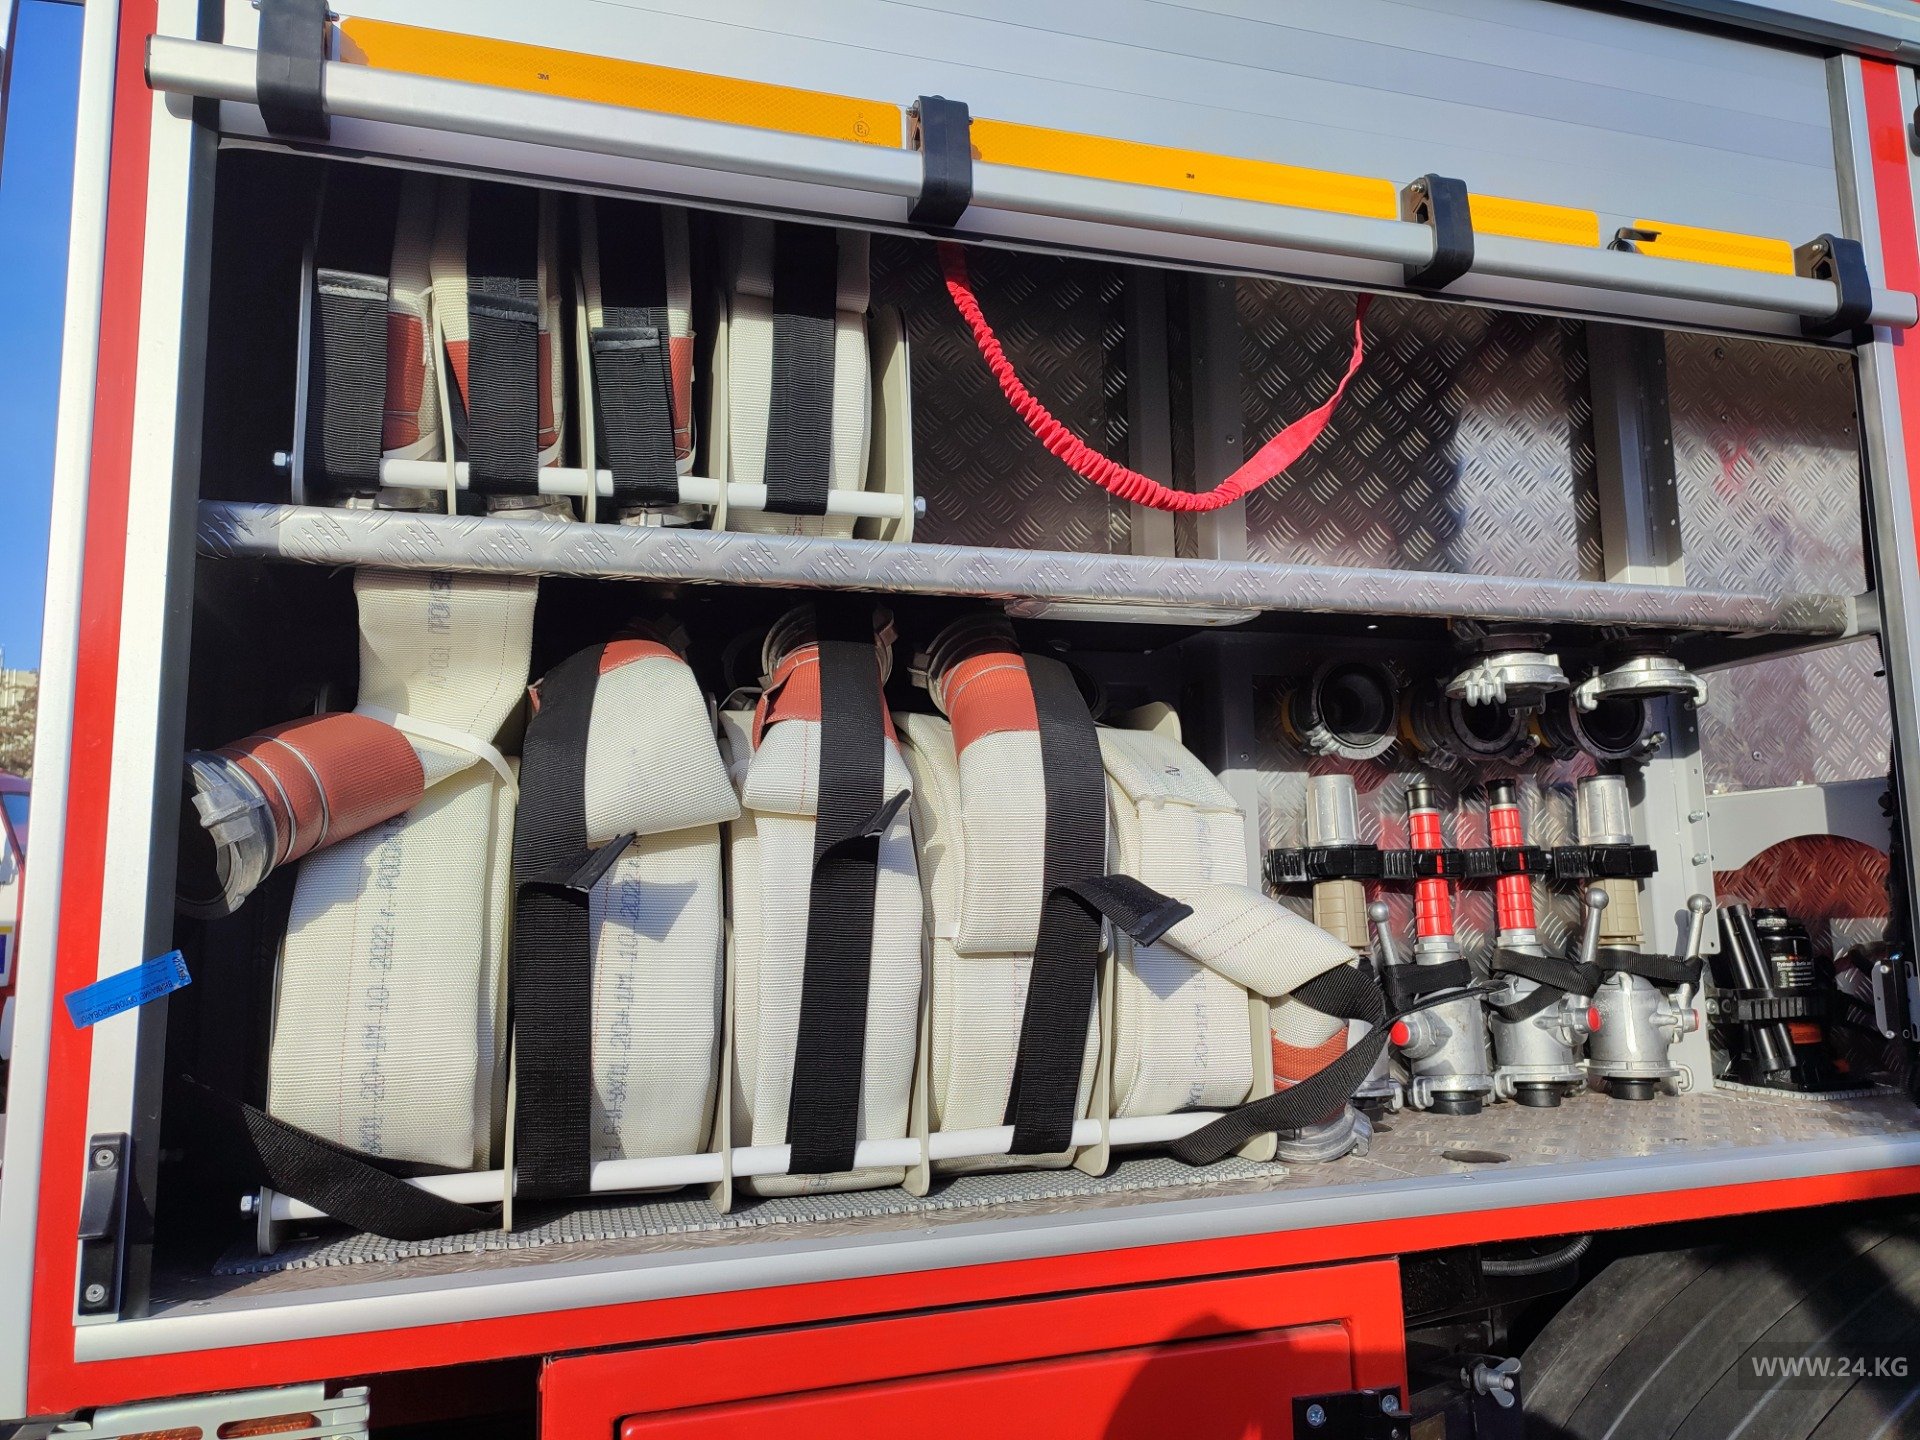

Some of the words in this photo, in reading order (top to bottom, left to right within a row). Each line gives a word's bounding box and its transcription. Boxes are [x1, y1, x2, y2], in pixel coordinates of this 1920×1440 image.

[619, 874, 641, 921] 2022
[368, 925, 395, 970] 2022
[364, 987, 390, 1013] 10
